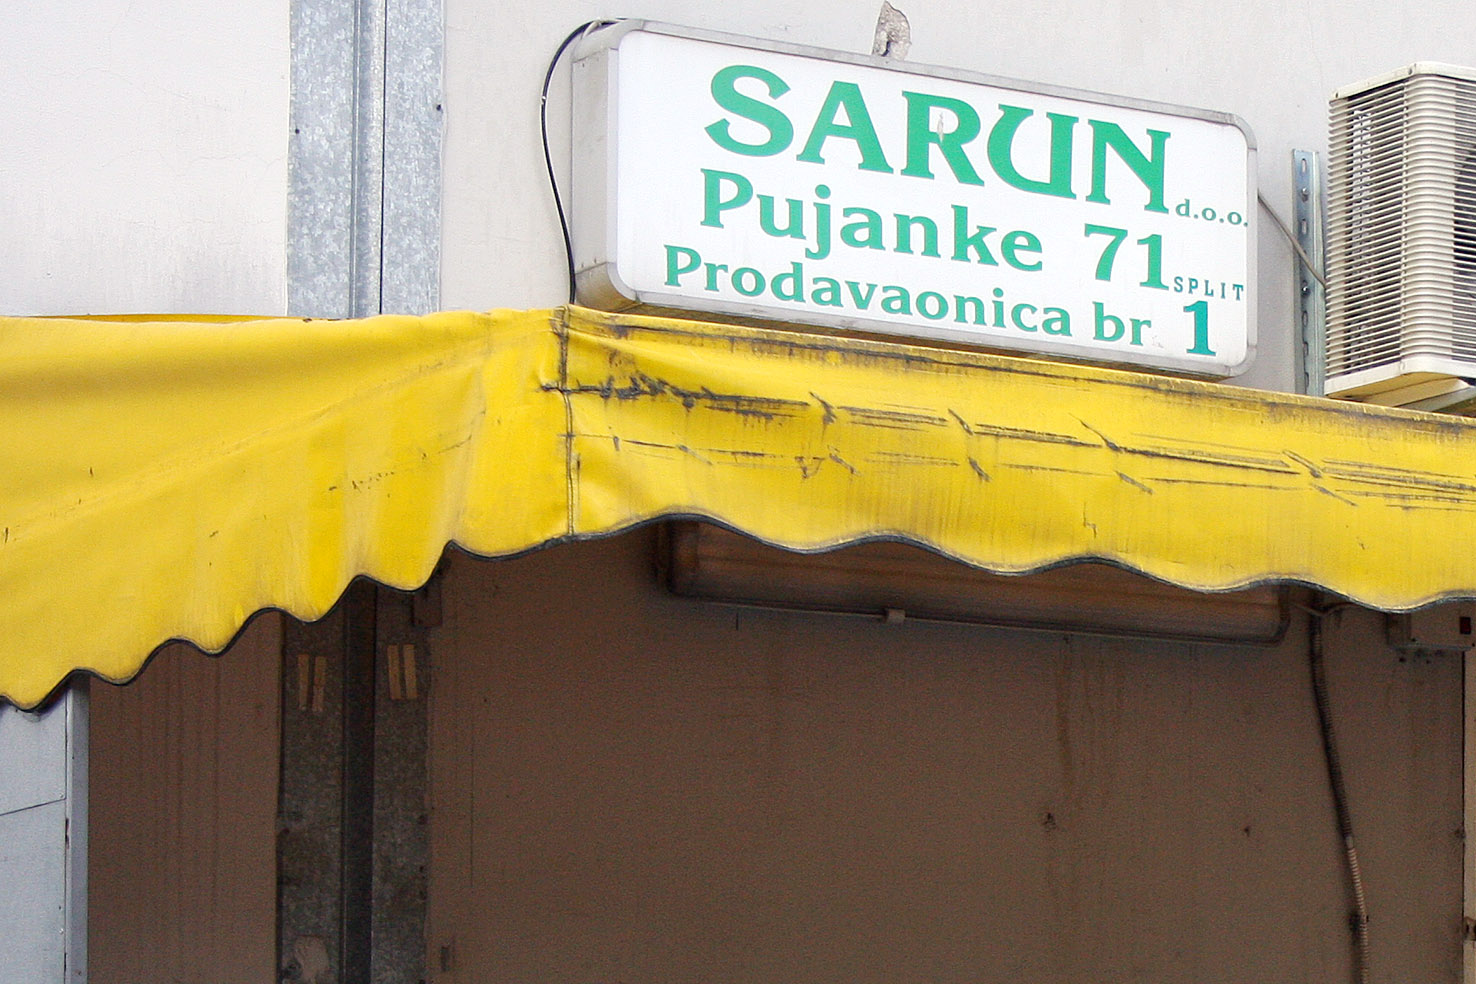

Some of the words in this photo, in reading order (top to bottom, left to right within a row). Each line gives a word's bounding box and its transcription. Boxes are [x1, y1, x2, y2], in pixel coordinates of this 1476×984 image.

[704, 64, 1171, 216] SARUN
[1175, 200, 1249, 228] d.o.o.
[663, 245, 1073, 339] Prodavaonica
[1092, 301, 1152, 347] br
[1182, 300, 1218, 357] 1
[700, 168, 1043, 274] Pujanke
[1083, 224, 1170, 292] 71
[1173, 274, 1245, 301] SPLIT
